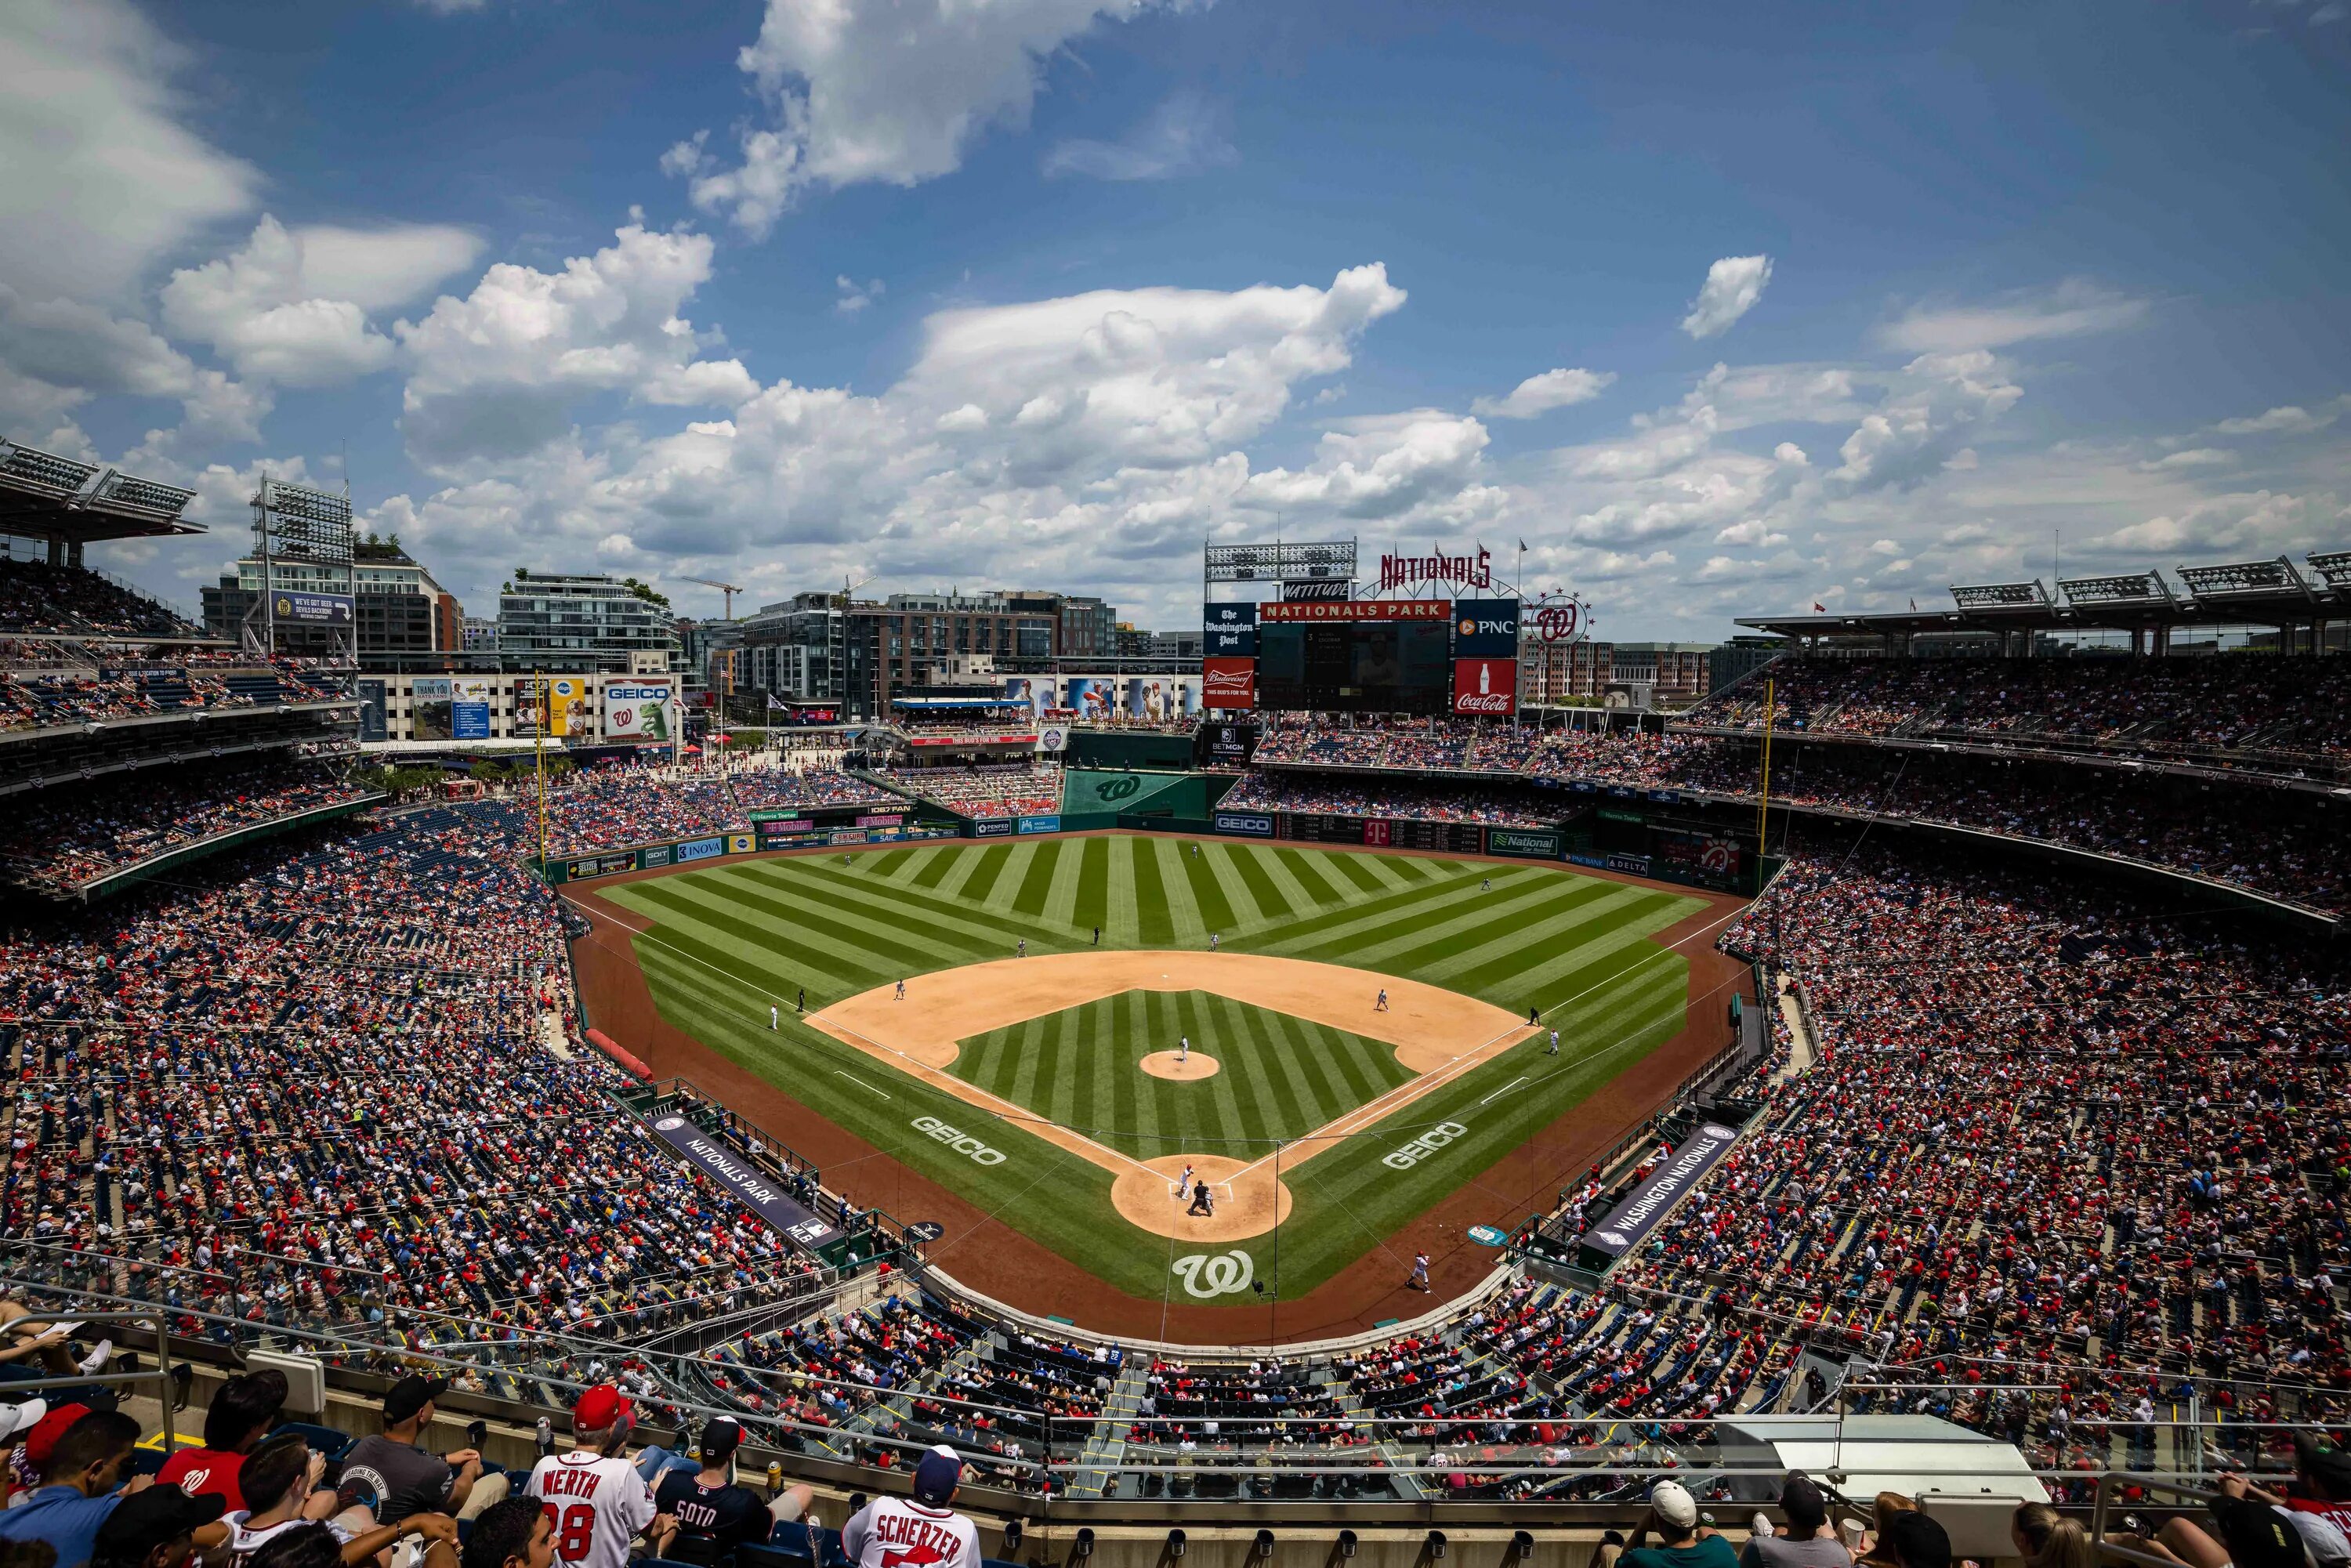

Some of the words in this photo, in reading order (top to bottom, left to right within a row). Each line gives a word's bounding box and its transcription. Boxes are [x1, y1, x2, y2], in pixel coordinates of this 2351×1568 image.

[1381, 552, 1491, 590] NATIONALS
[1284, 583, 1348, 598] NATITUDE
[1222, 610, 1237, 620] The
[1266, 605, 1378, 617] NATIONALS
[1388, 604, 1440, 615] PARK
[1205, 621, 1253, 633] Washington
[1477, 621, 1514, 634] PNC
[1219, 635, 1238, 647] Post
[1208, 673, 1248, 683] Budweiser
[436, 685, 447, 693] YOU
[609, 689, 668, 699] GEICO
[1457, 693, 1512, 711] Coca-Cola
[1219, 818, 1269, 831] GEICO
[690, 842, 719, 856] INOVA
[1617, 860, 1646, 872] DELTA
[910, 1117, 1007, 1165] GEICO
[1382, 1122, 1468, 1170] GEICO
[686, 1139, 748, 1182] NATIONALS
[740, 1179, 779, 1204] PARK
[1613, 1175, 1682, 1231] WASHINGTON
[1669, 1138, 1719, 1182] NATIONALS
[786, 1224, 813, 1244] MLB
[910, 1225, 934, 1240] CUTWATER
[345, 1467, 366, 1478] LEADING
[366, 1469, 377, 1479] THE
[374, 1477, 386, 1490] WAY
[542, 1469, 602, 1500] WERTH
[676, 1500, 717, 1527] SOTO
[877, 1515, 962, 1564] SCHERZER
